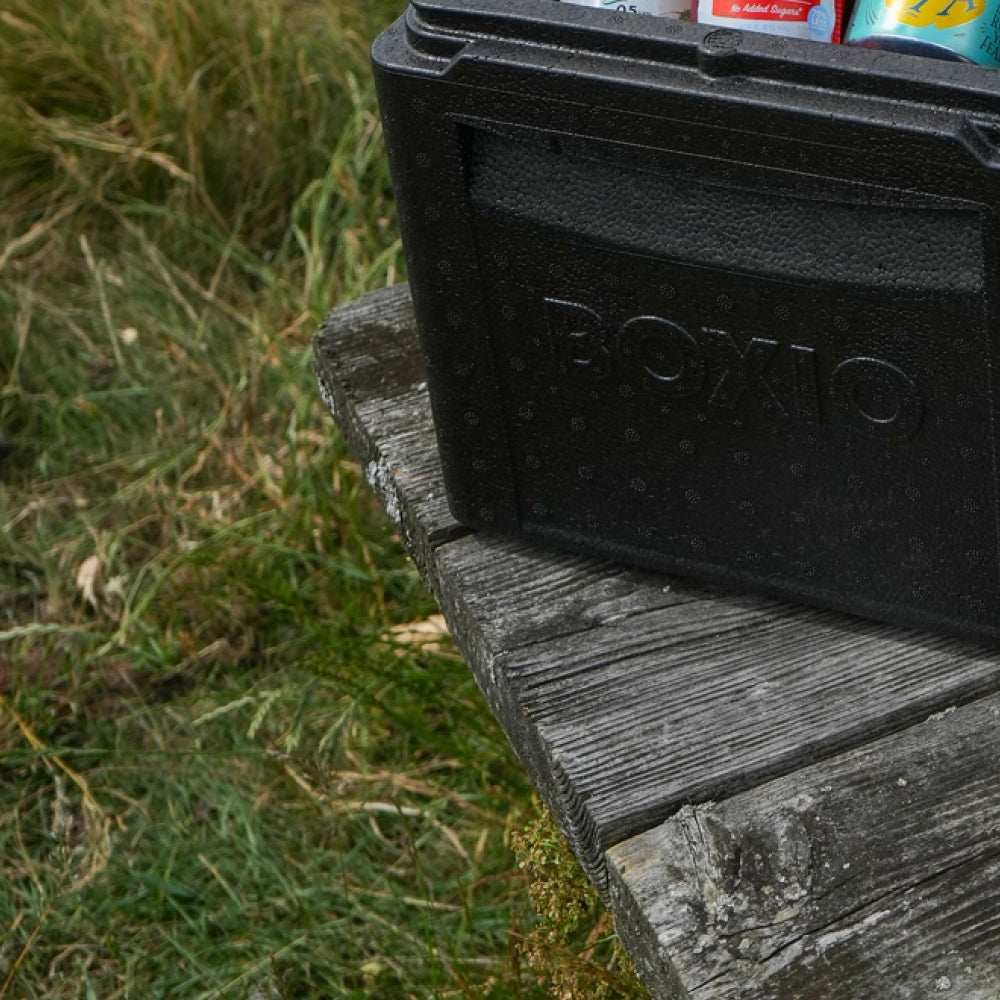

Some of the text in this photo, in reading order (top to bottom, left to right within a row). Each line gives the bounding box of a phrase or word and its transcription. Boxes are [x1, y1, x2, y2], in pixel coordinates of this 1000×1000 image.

[730, 4, 741, 12] No
[742, 2, 771, 13] Added
[543, 296, 926, 442] BOXIO
